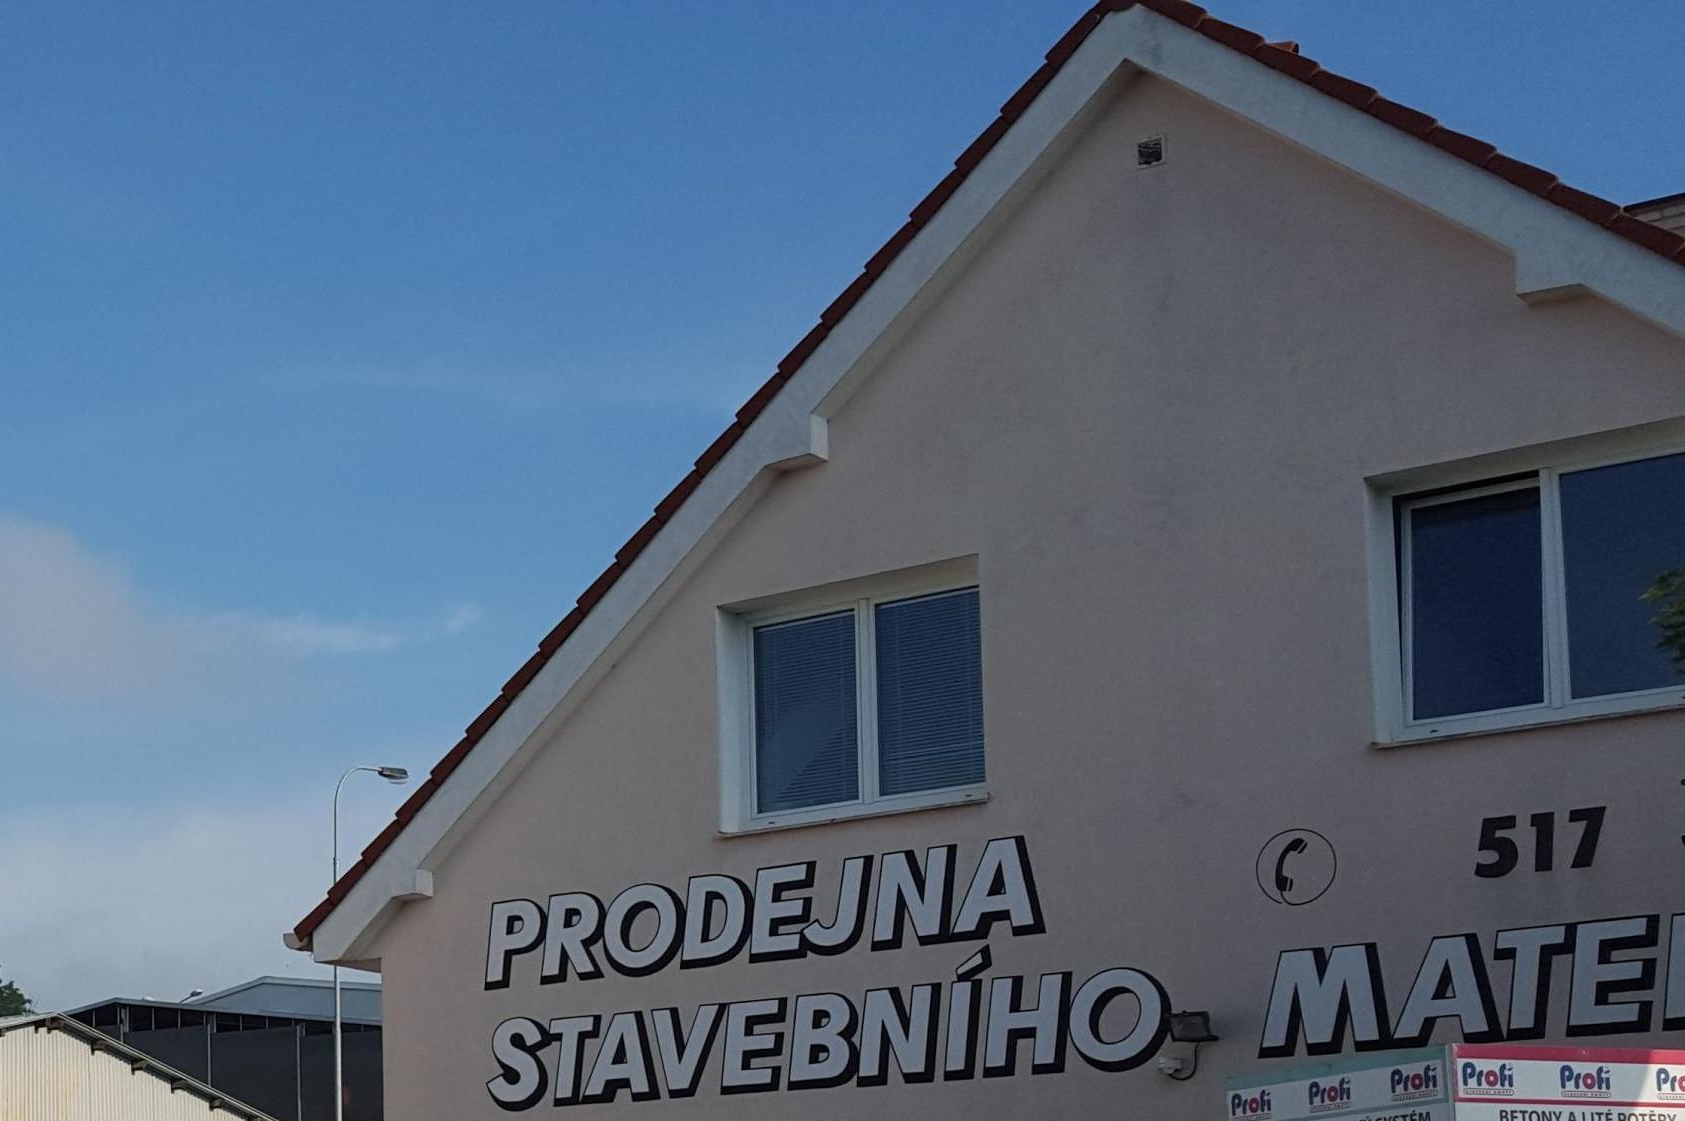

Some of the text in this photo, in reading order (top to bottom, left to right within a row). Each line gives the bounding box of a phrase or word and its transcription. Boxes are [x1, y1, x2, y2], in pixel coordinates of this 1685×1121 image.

[1474, 806, 1607, 878] 517
[484, 835, 1046, 990] PRODEJNA
[485, 914, 1685, 1111] STAVEBNÍHO MATE
[1390, 1064, 1438, 1093] Profi
[1462, 1061, 1514, 1088] Profi
[1560, 1064, 1611, 1090] Profi
[1231, 1088, 1272, 1116] Profi
[1308, 1077, 1351, 1105] Profi
